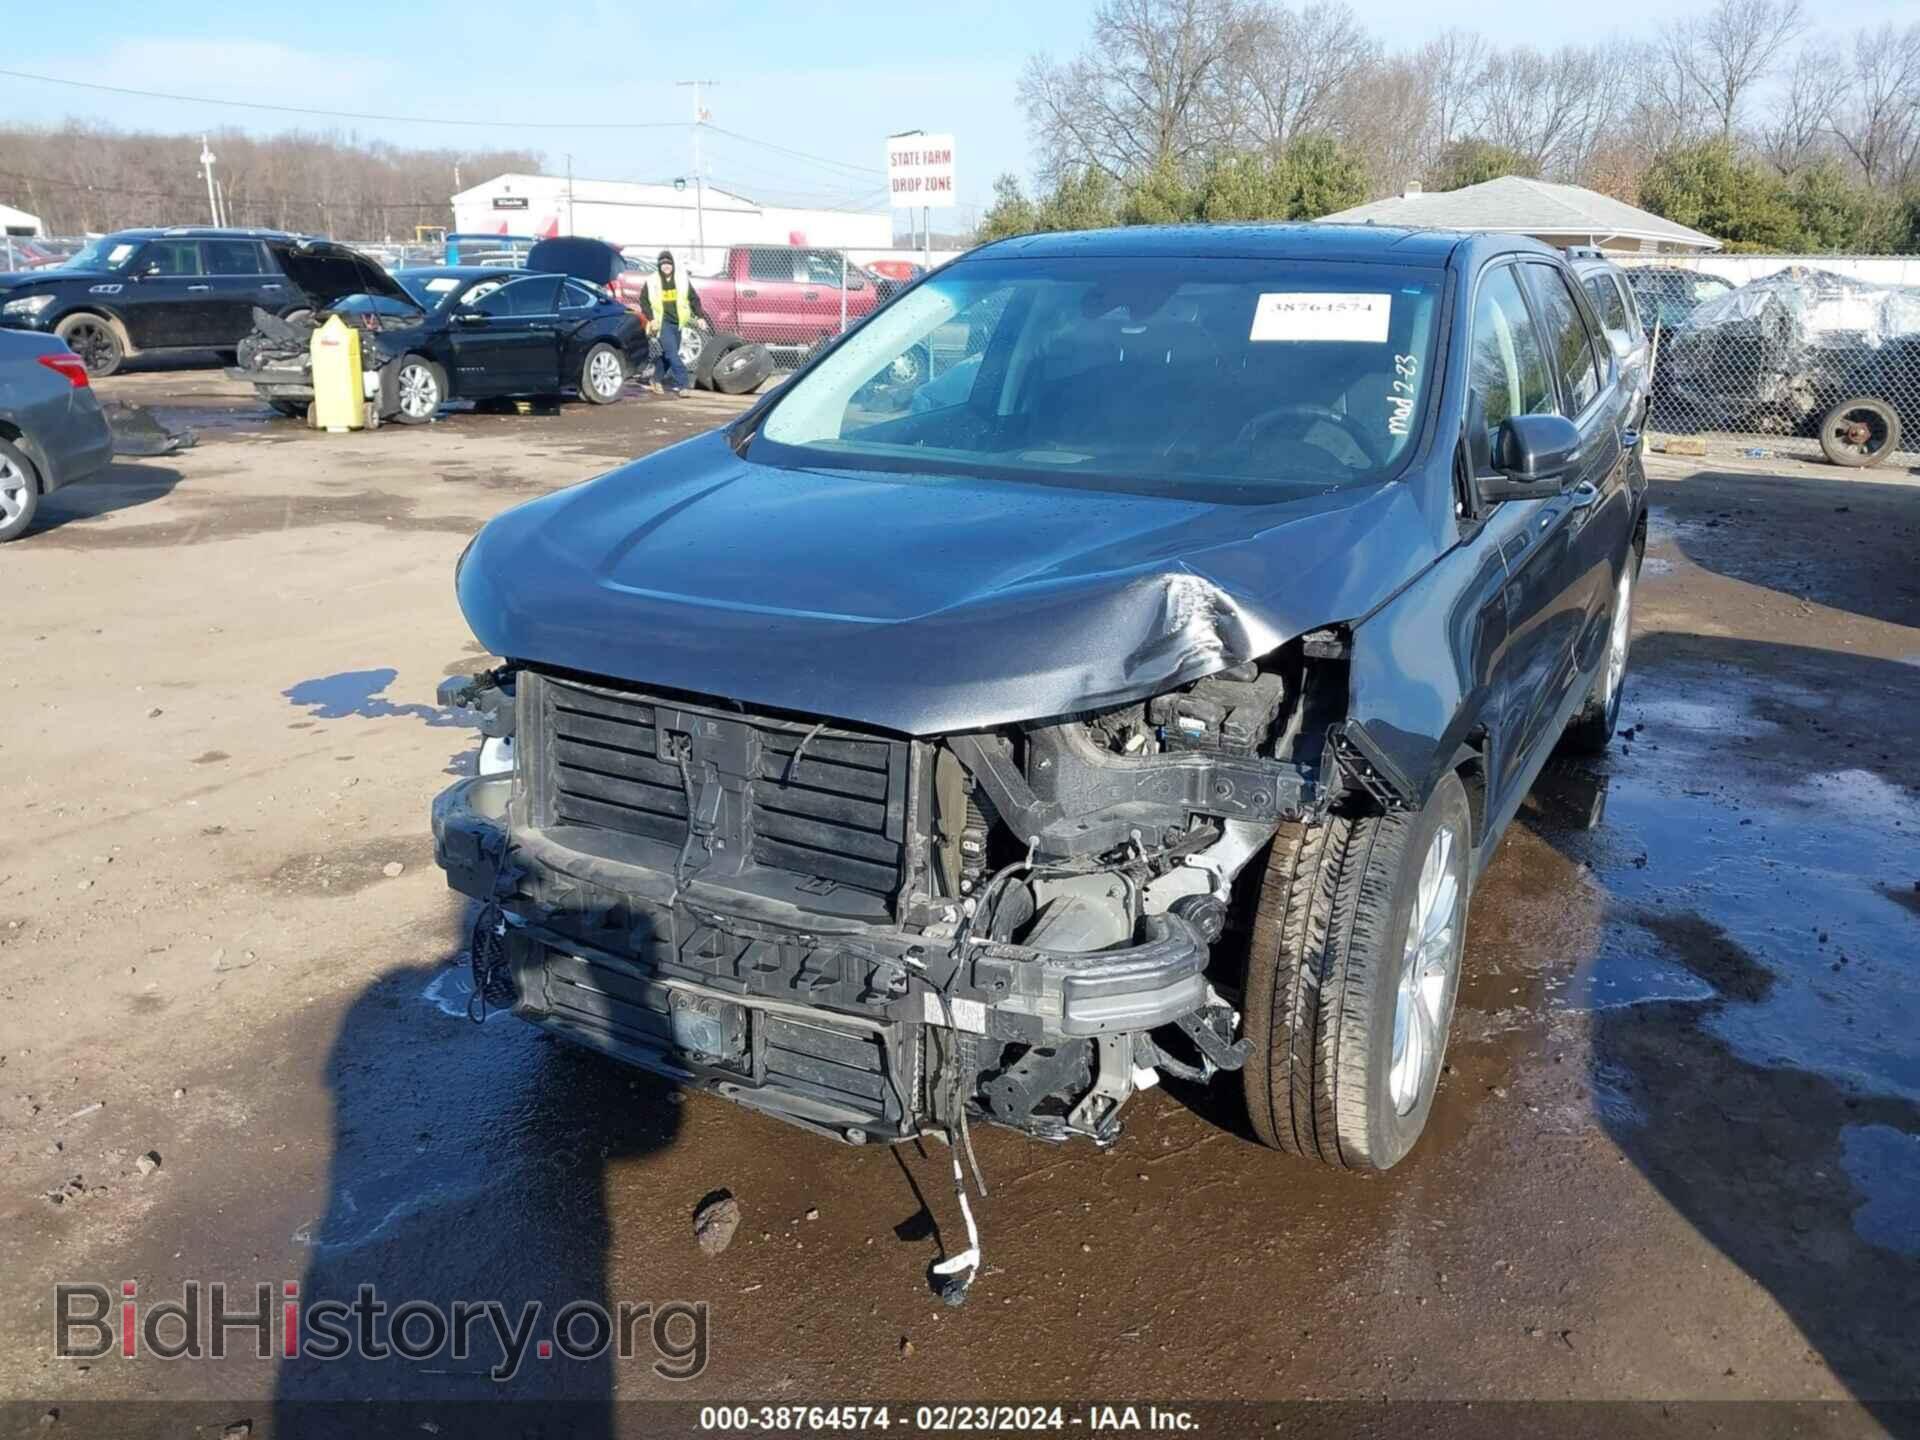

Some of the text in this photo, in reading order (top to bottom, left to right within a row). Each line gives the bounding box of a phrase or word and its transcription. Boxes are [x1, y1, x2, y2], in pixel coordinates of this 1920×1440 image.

[891, 150, 951, 167] STATE FARM
[892, 176, 951, 192] DROP ZONE
[1269, 303, 1372, 312] 38764574
